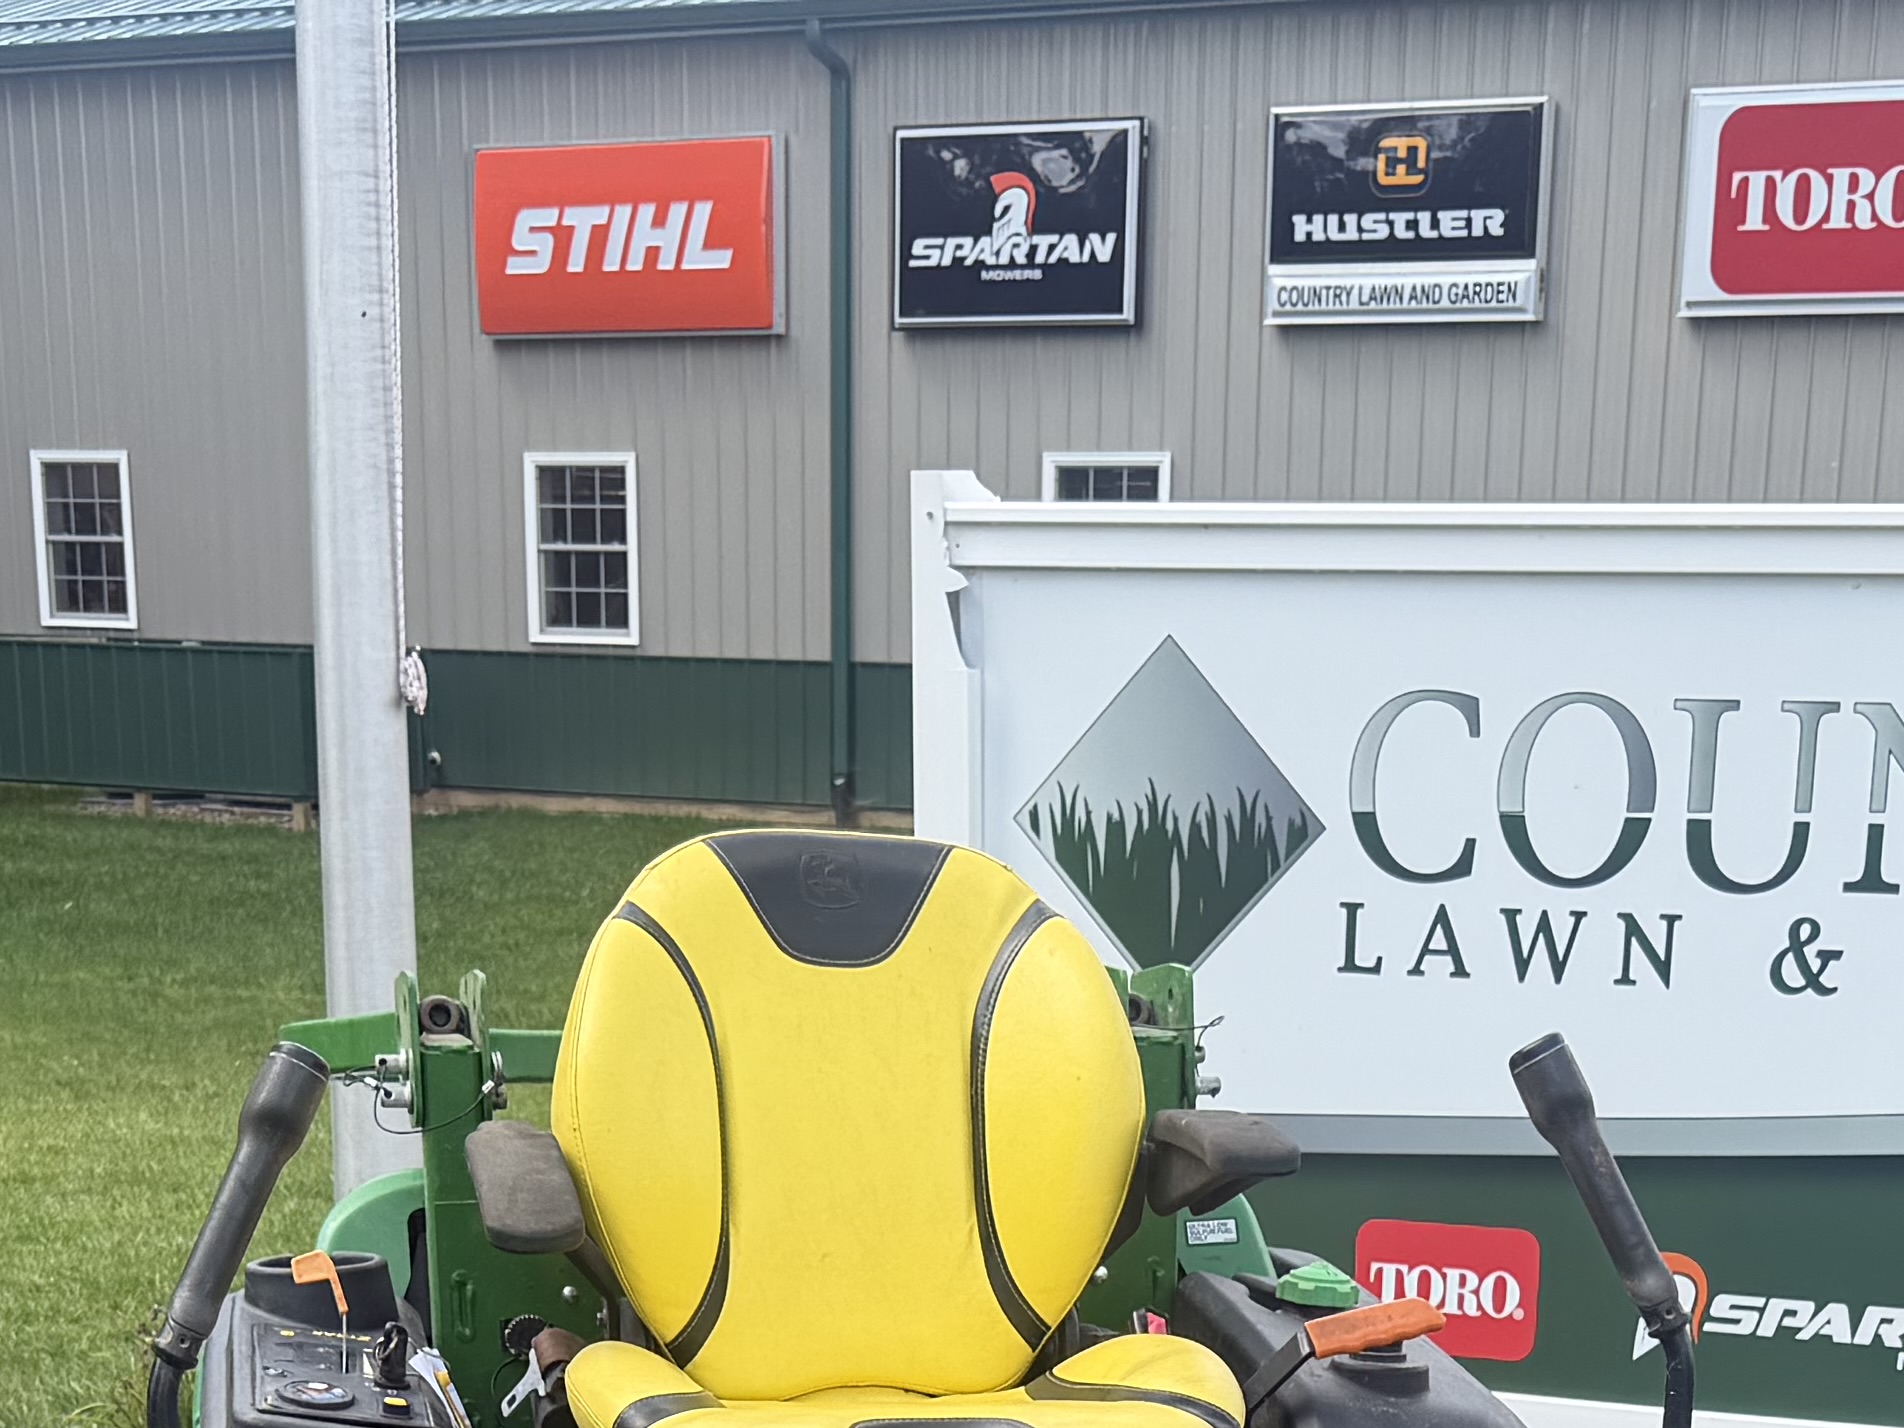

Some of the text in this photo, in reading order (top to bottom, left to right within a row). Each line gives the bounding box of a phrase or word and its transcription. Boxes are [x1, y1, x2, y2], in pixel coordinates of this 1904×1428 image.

[504, 200, 734, 275] STIHL
[1292, 208, 1505, 242] HUSTLER
[908, 232, 1117, 268] SPARTAN
[980, 267, 1043, 281] MOWERS
[1276, 281, 1519, 308] COUNTRY LAWN AND GARDEN
[1336, 901, 1683, 991] LAWN
[1768, 916, 1844, 998] &
[1369, 1261, 1521, 1321] TORO
